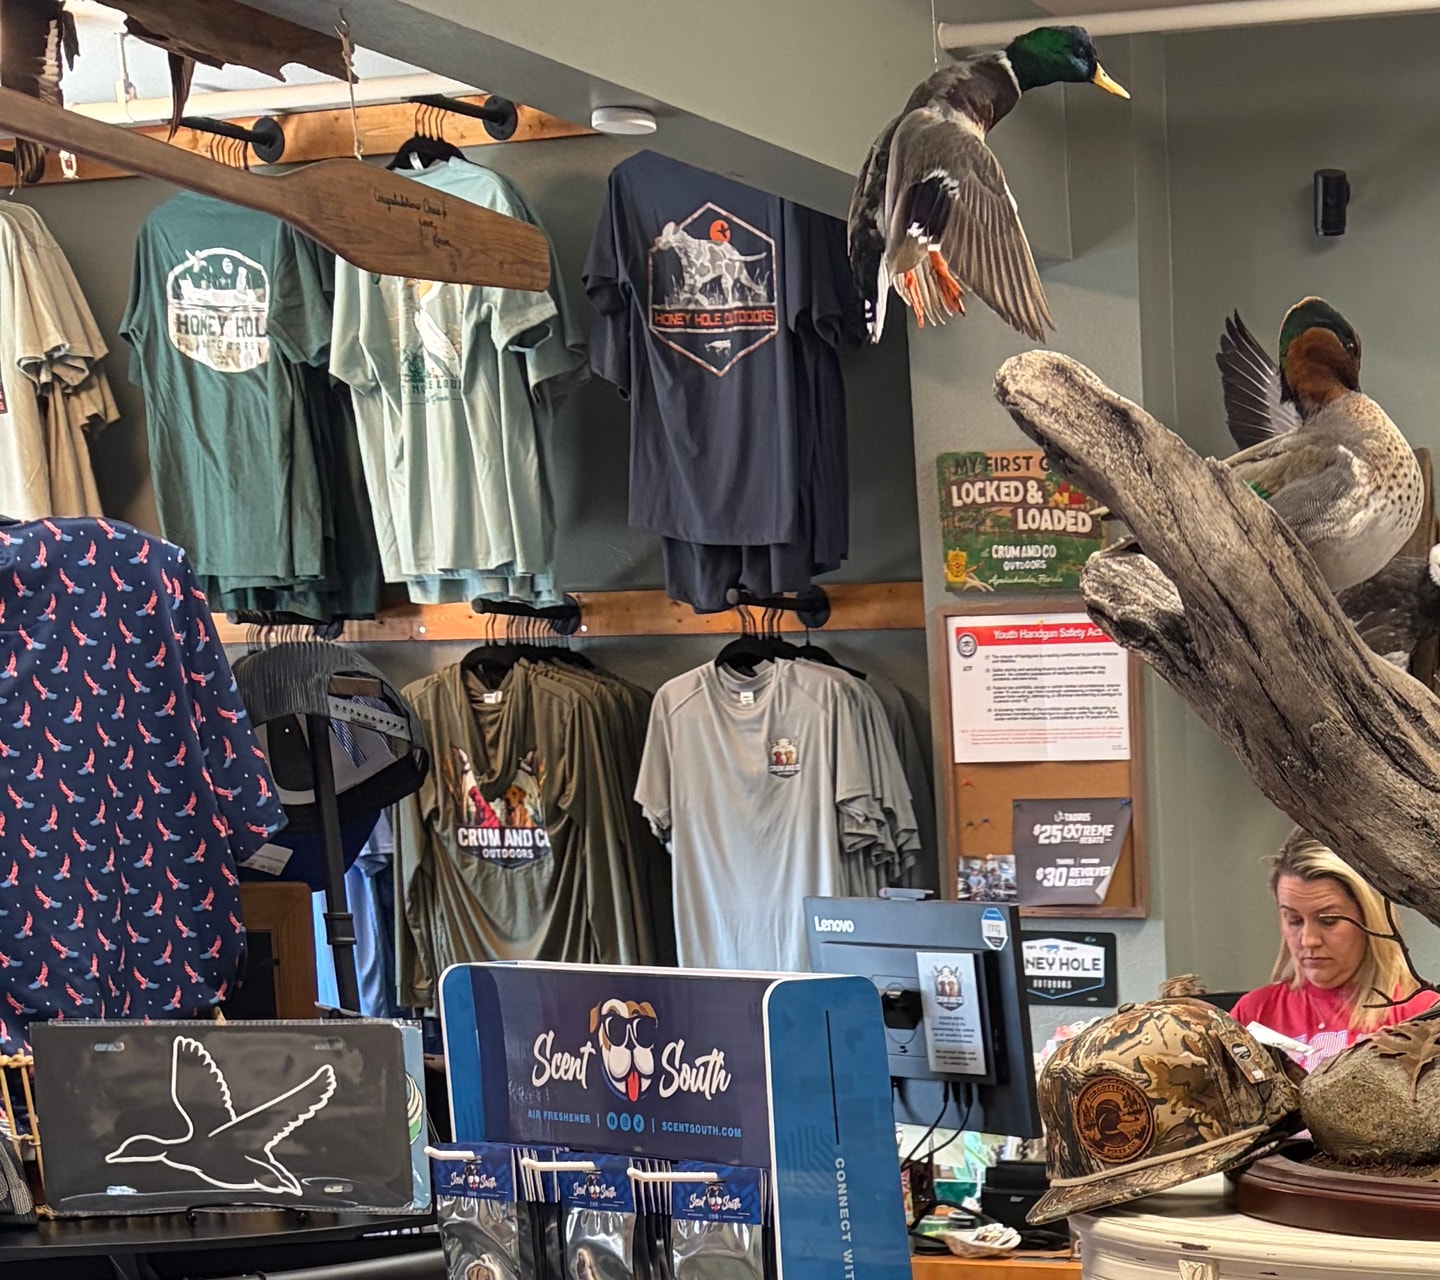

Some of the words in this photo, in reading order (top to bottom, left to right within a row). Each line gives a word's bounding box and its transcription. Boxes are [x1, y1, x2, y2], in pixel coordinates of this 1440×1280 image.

[176, 313, 227, 336] HONEY
[236, 315, 267, 337] HOL
[655, 313, 690, 324] HONEY
[695, 313, 721, 325] HOLE
[725, 310, 773, 323] OUTDOORS
[986, 456, 1033, 472] FIRST
[952, 480, 1024, 507] LOCKED
[1027, 480, 1043, 504] &
[1017, 509, 1092, 533] LOADED
[992, 545, 1020, 558] CRUM
[1020, 545, 1041, 557] AND
[1042, 546, 1056, 557] CO
[1004, 561, 1047, 571] OUTDOORS
[994, 630, 1018, 639] Youth
[1020, 630, 1057, 641] Handgun
[1060, 628, 1085, 639] Safety
[458, 828, 500, 846] CRUM
[505, 829, 533, 847] AND
[1033, 824, 1063, 844] $25
[1063, 825, 1114, 837] EXTREME
[482, 849, 534, 858] OUTDOORS
[1036, 867, 1067, 887] $30
[814, 916, 854, 932] Lenovo
[1025, 957, 1056, 970] NEY
[1060, 958, 1101, 971] HOLE
[1033, 979, 1071, 989] OUTDOORS
[531, 1030, 596, 1089] Scent
[658, 1039, 732, 1100] South
[528, 1108, 542, 1120] AIR
[544, 1111, 590, 1124] FRESHENER
[661, 1121, 742, 1138] SCENTSOUTH.COM
[835, 1156, 852, 1242] CONNECT
